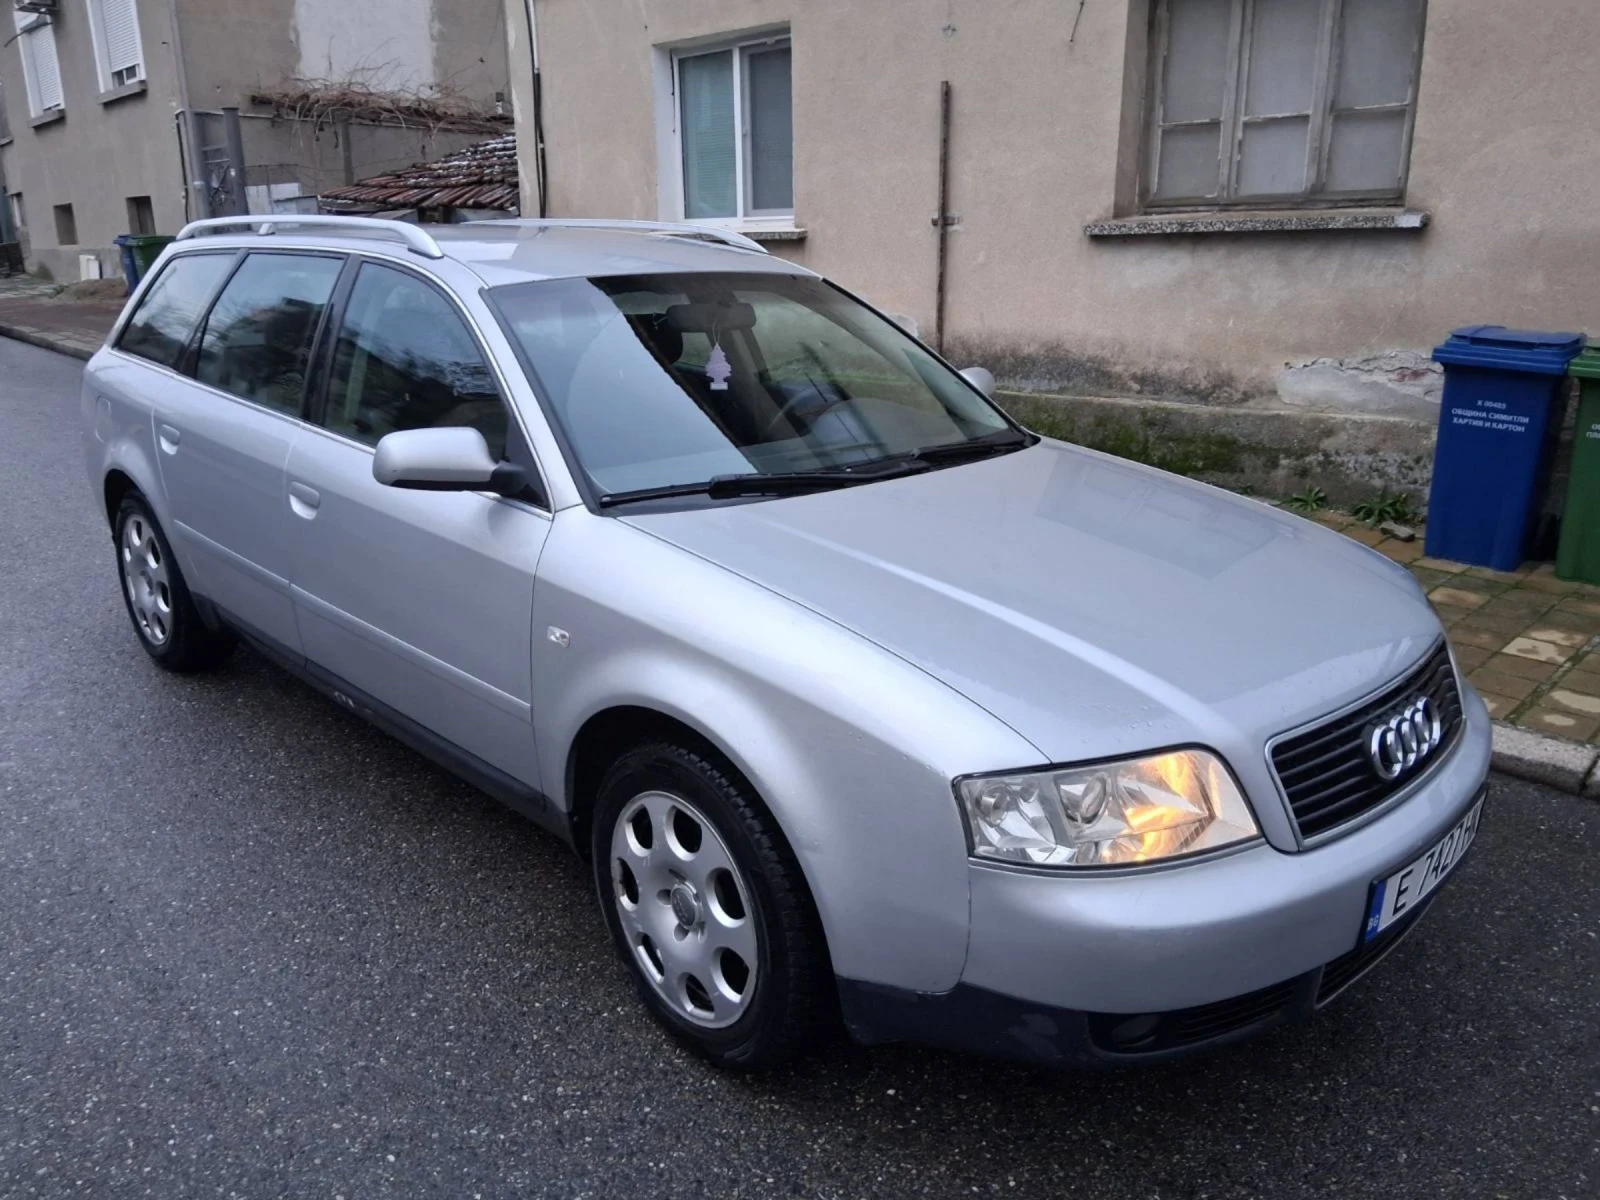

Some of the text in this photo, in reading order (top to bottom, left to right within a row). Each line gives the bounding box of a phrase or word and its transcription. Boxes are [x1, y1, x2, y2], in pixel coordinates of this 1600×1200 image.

[1452, 408, 1529, 423] ОБЩИНА СИМИТЛИ
[1453, 417, 1483, 427] ХАРТИЯ
[1492, 422, 1525, 432] КАРТОН
[1392, 868, 1414, 916] E
[1418, 820, 1464, 896] 7427
